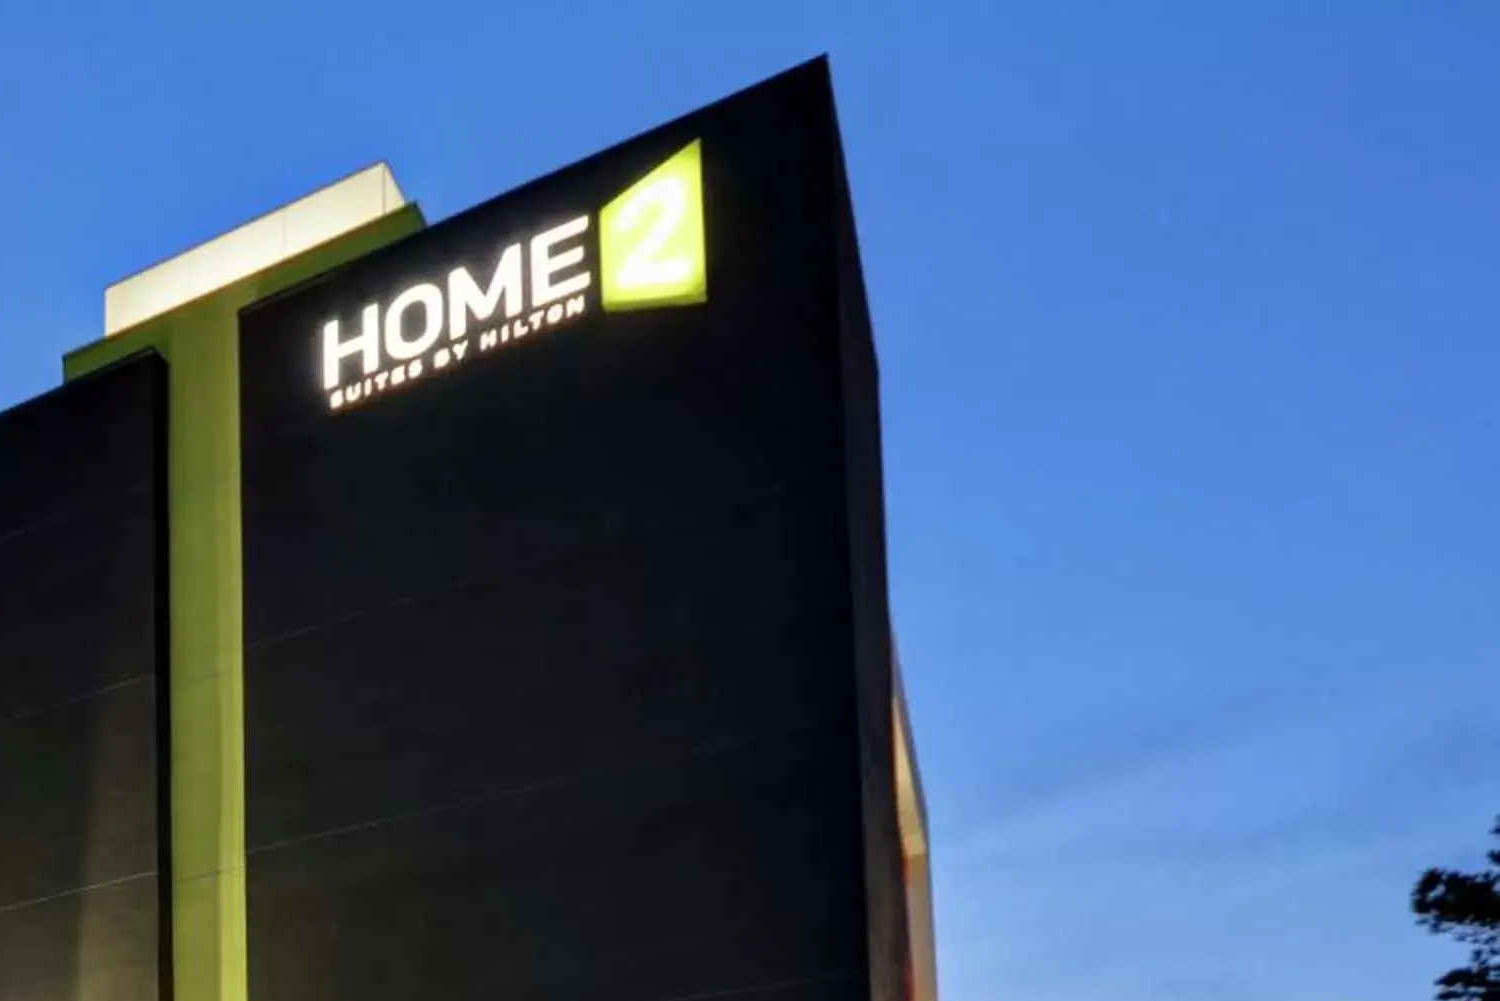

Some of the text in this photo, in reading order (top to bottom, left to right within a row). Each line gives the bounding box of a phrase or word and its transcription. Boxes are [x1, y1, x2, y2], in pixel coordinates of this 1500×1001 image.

[323, 175, 693, 390] HOME 2
[329, 293, 586, 410] SUITES BY HILTON
